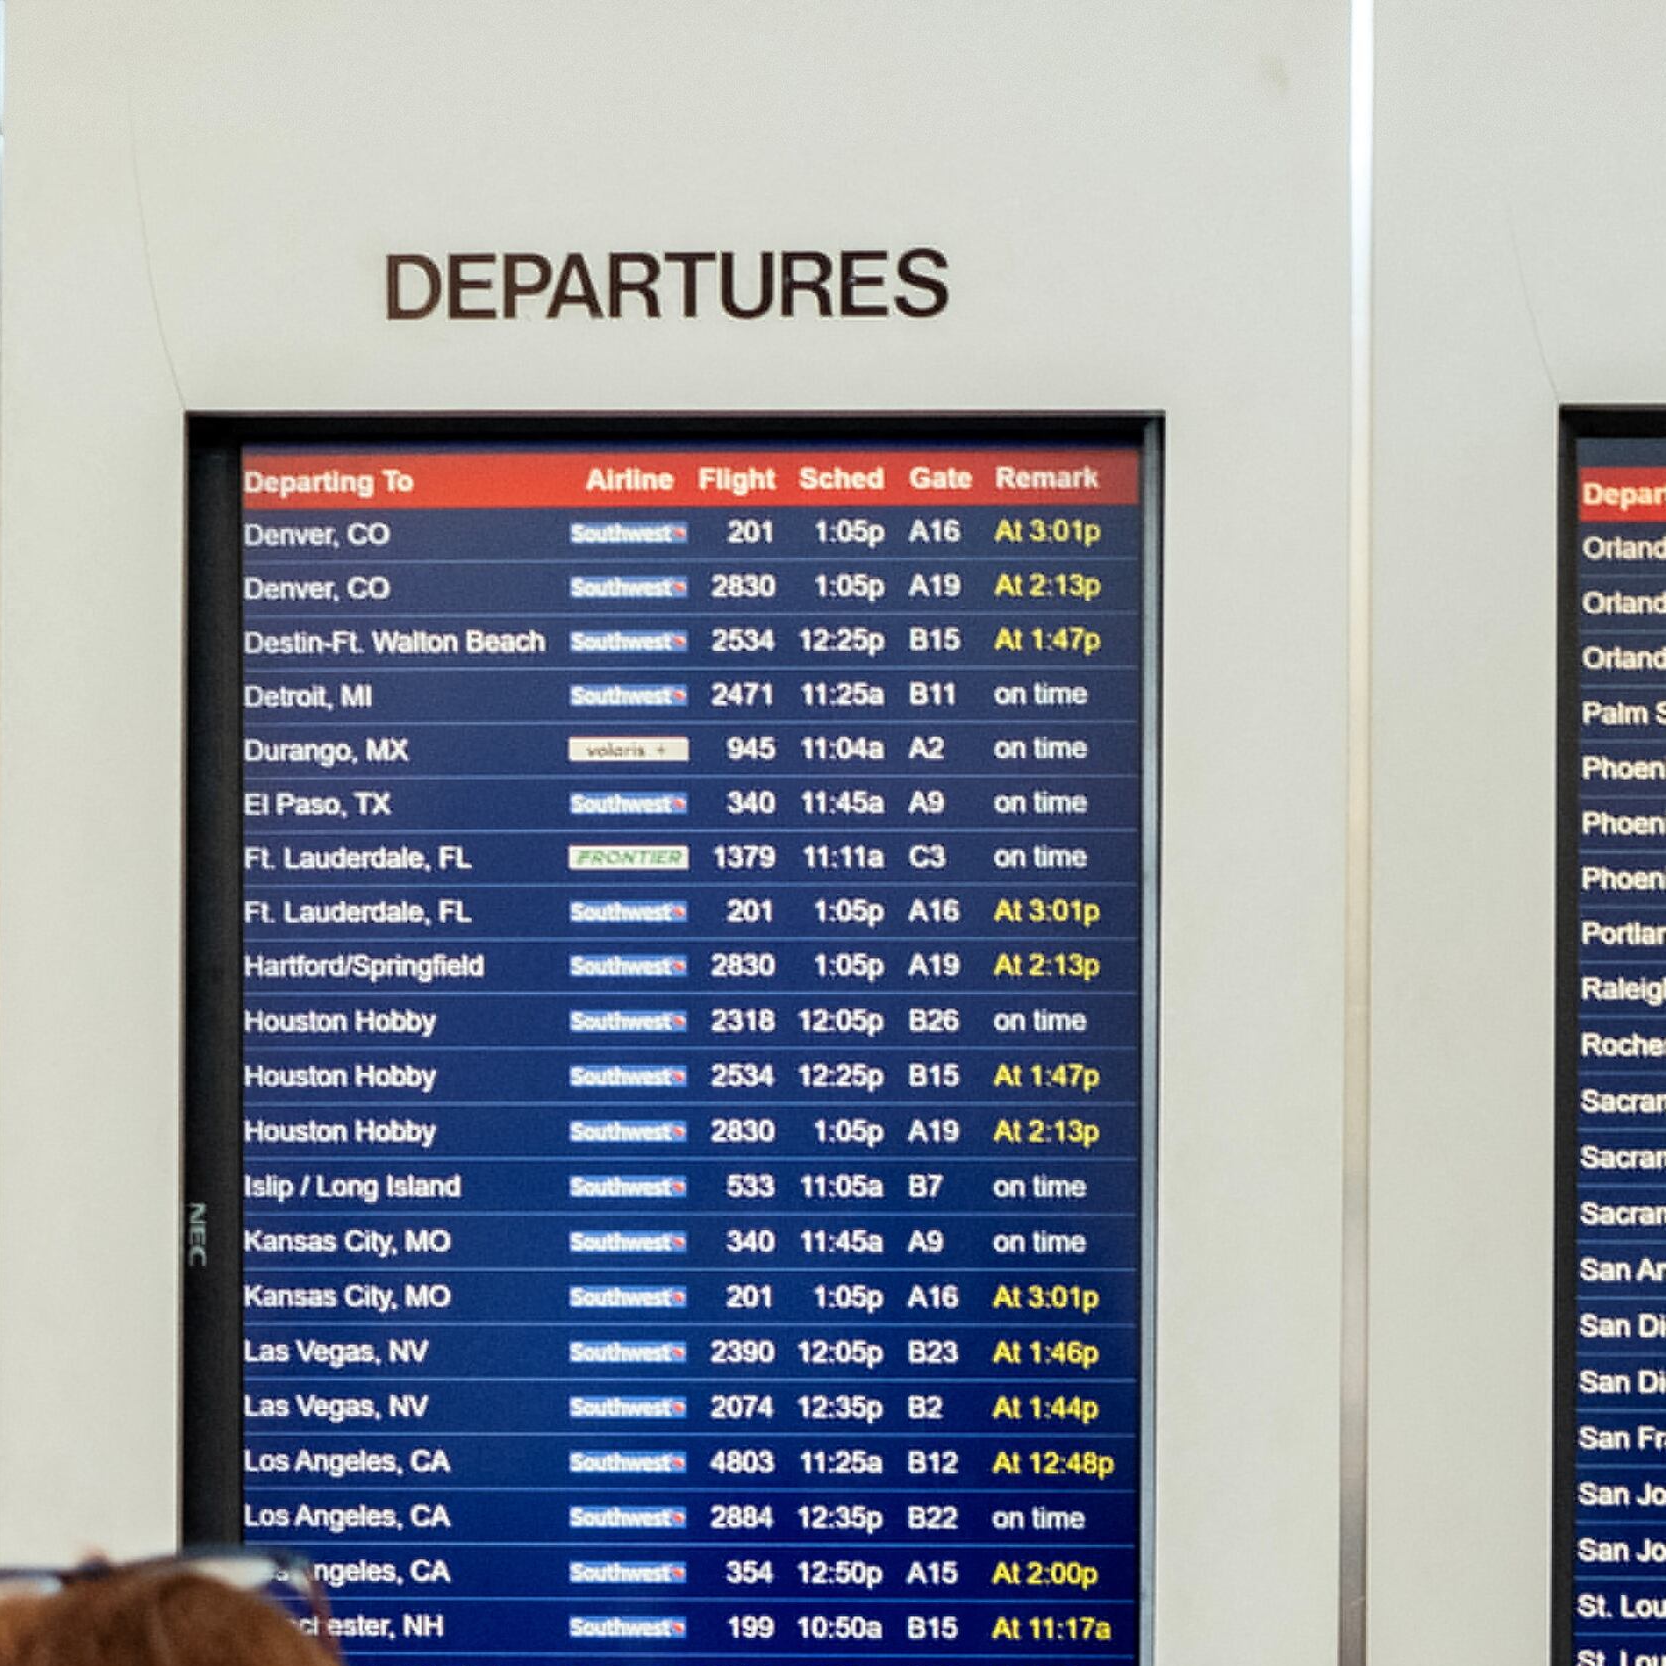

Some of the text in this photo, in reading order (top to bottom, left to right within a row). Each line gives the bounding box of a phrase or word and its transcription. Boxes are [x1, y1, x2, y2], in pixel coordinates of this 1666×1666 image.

[386, 247, 949, 320] DEPARTURES
[244, 466, 1099, 499] Departing To Airline Flight Sched Gate Remark
[244, 627, 1101, 657] Destin-Ft. Walton Beach Southwest 2534 12:25p B15 At 1:47p
[1582, 700, 1649, 725] Palm
[244, 844, 1088, 872] Ft. Lauderdale, FL FRONTIER 1379 11:11a C3 on time
[187, 1201, 208, 1267] NEC
